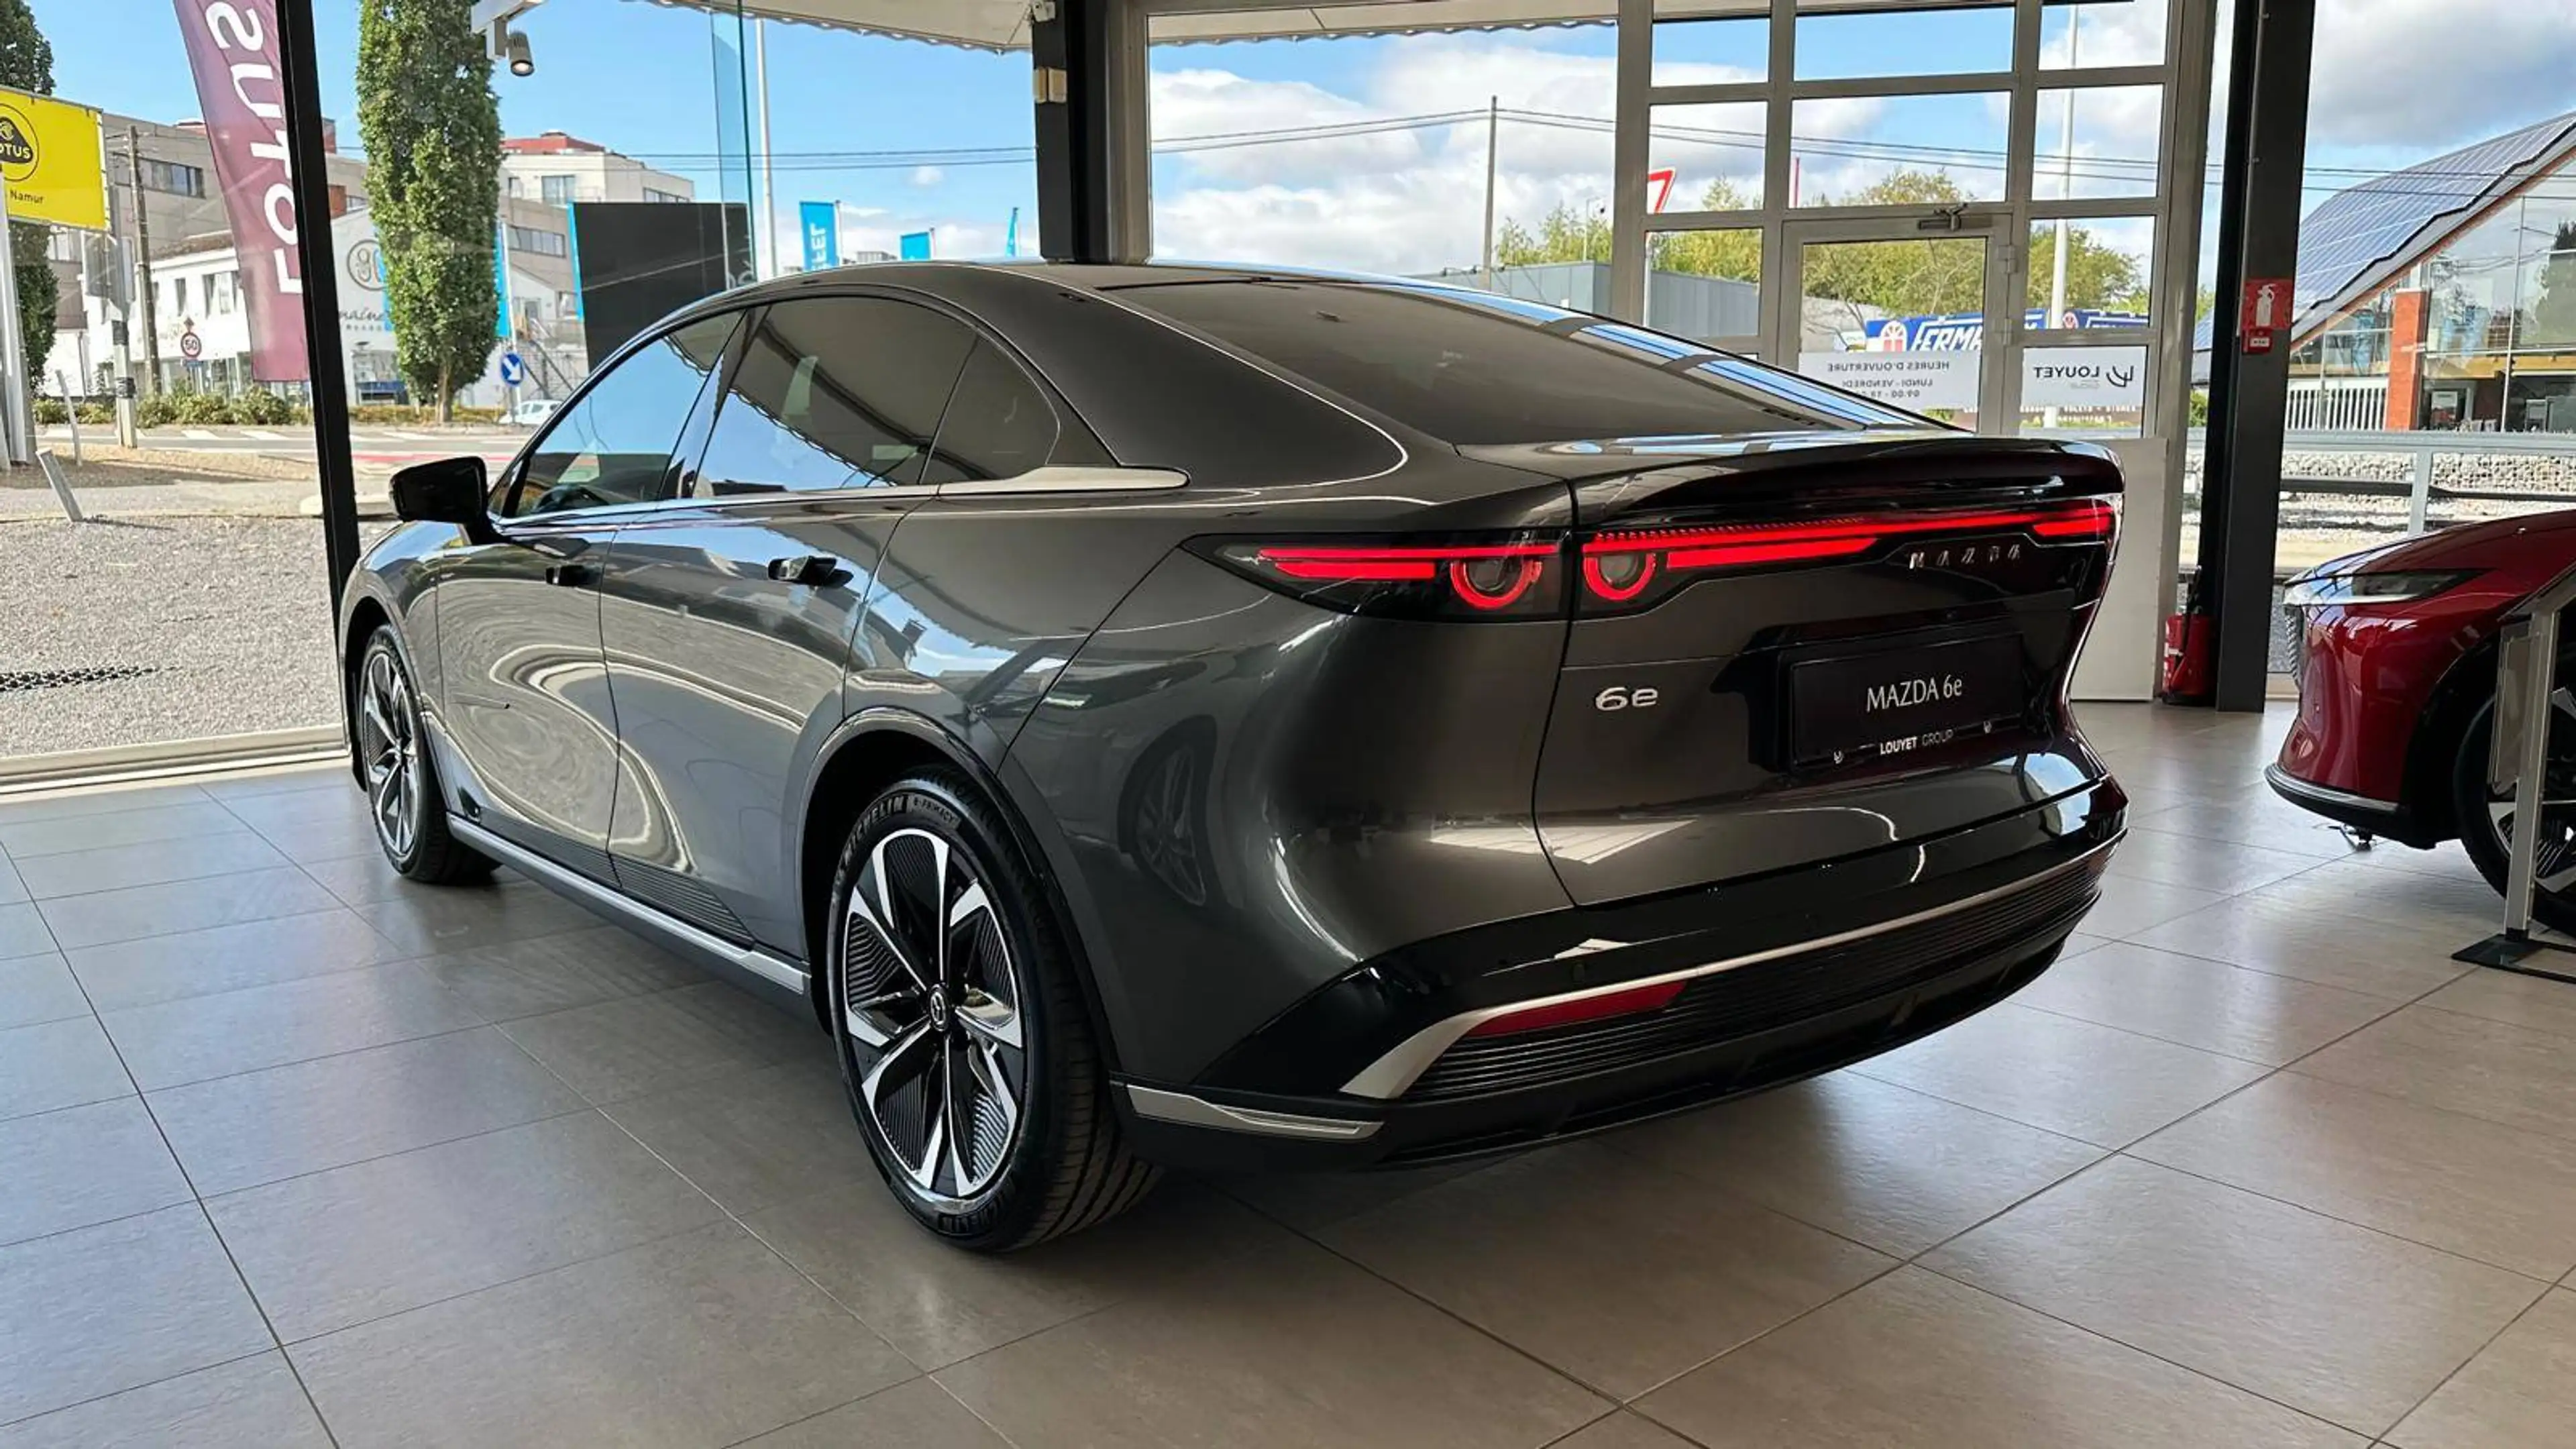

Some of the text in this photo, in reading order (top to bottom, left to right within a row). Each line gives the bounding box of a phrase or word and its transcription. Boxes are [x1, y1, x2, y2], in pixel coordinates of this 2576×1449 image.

[10, 189, 44, 204] Namur
[185, 339, 197, 350] 50
[1909, 544, 2020, 569] MAZDA
[1595, 686, 1658, 711] 6e
[1866, 674, 1963, 712] MAZDA 6e
[1880, 729, 1954, 755] LOUYET GROUP
